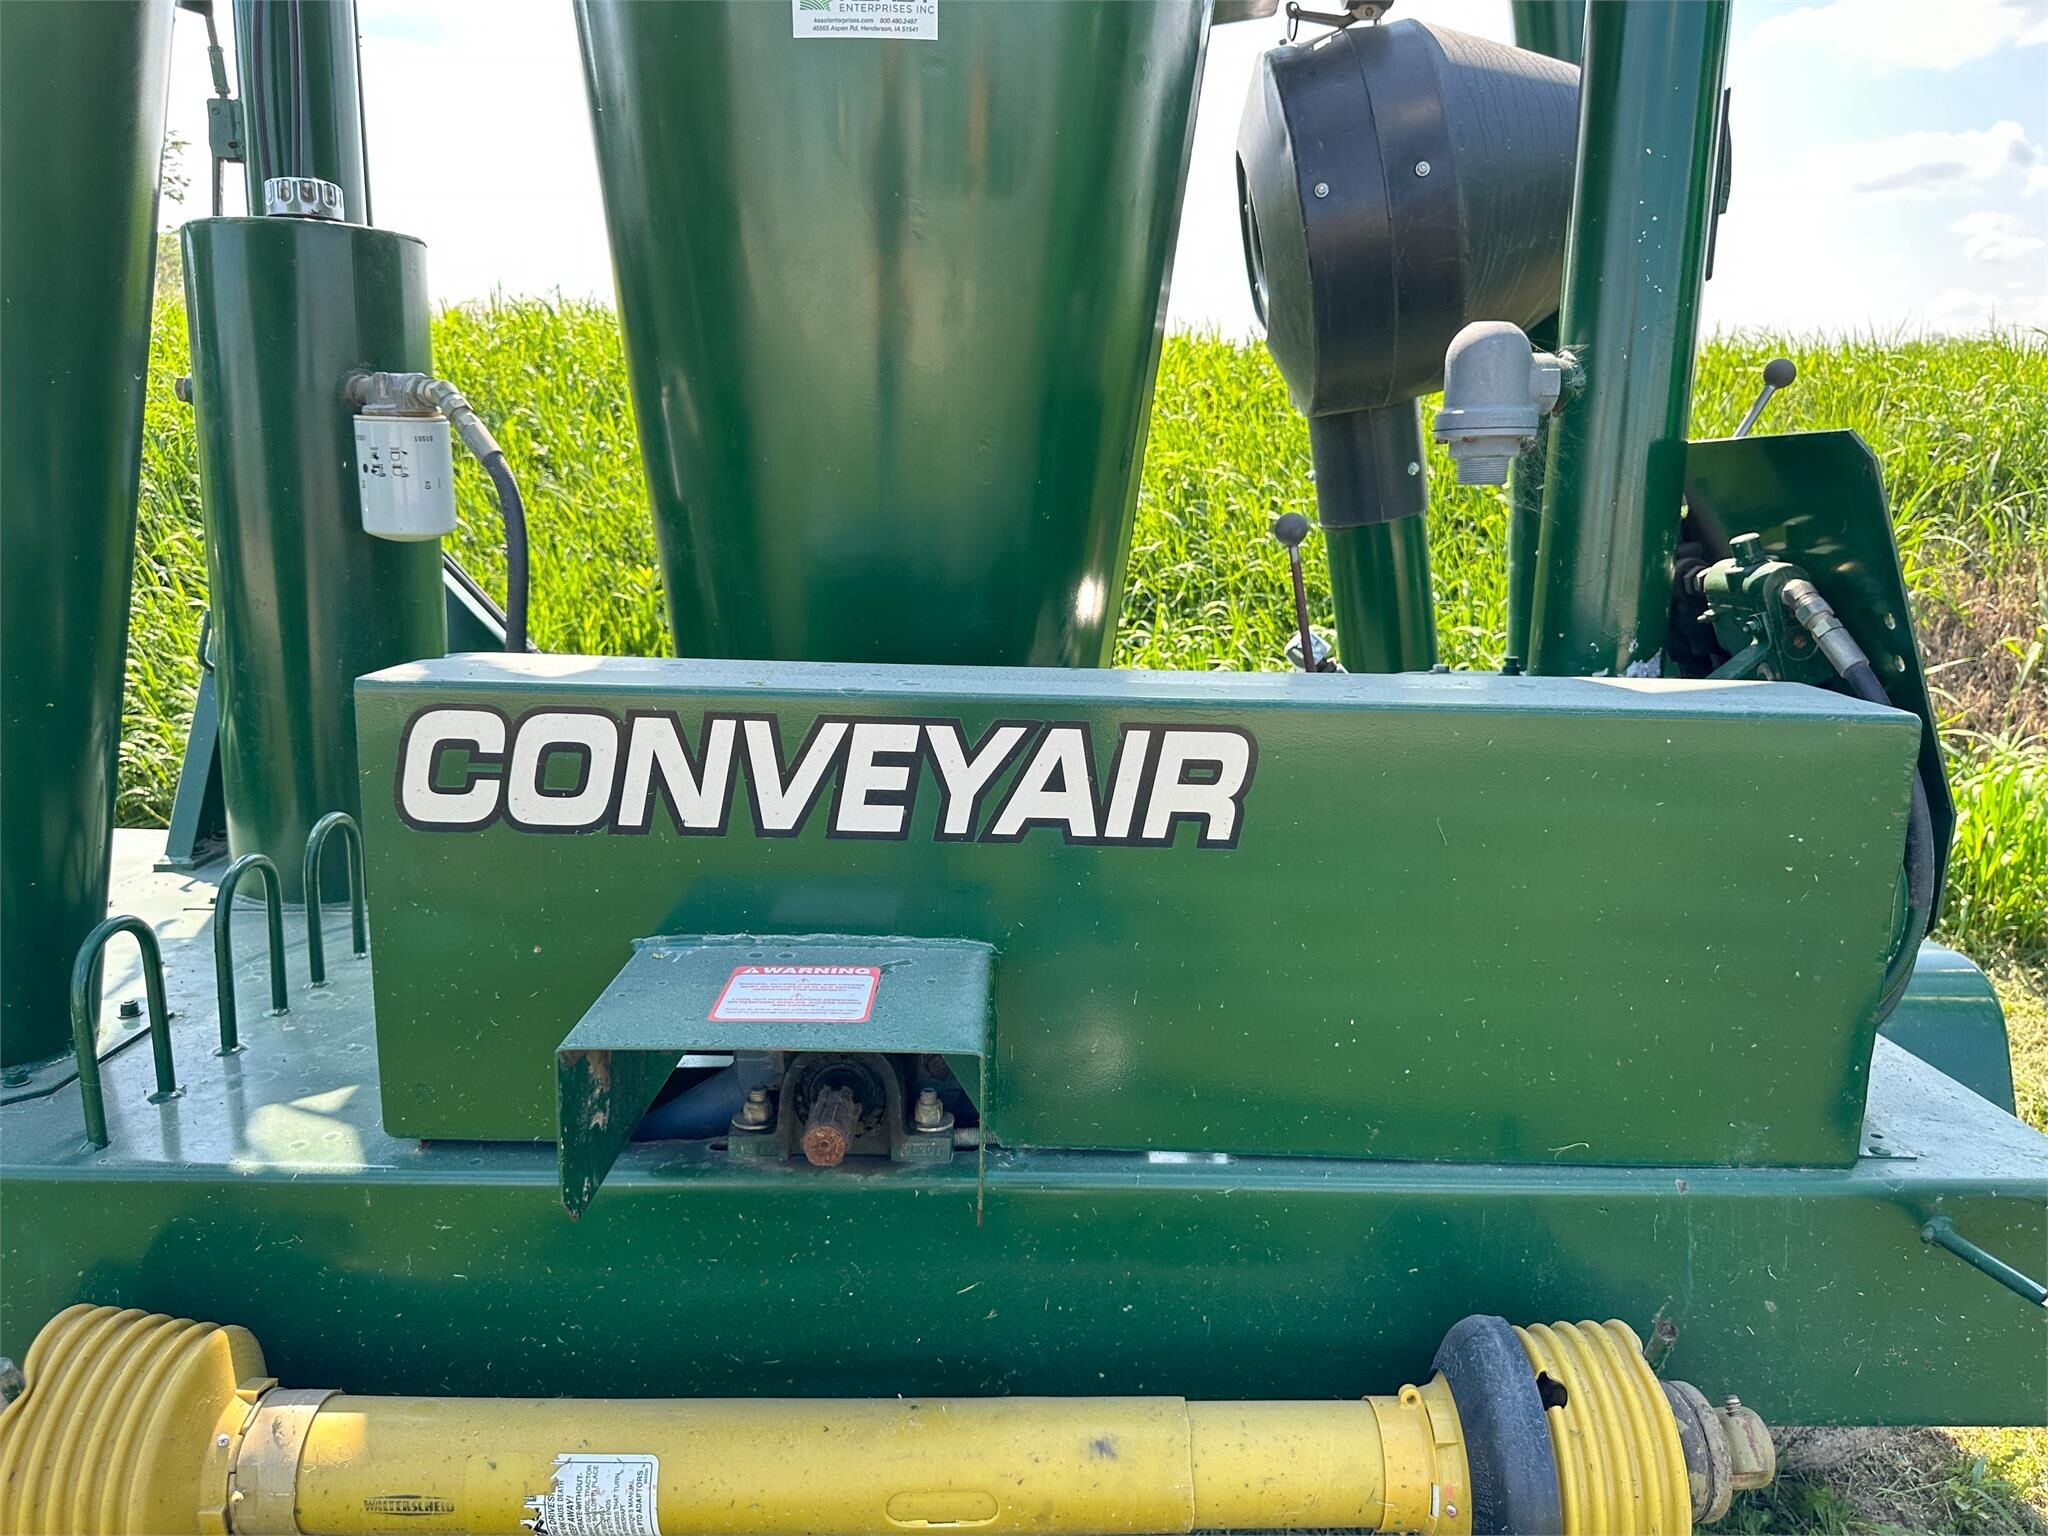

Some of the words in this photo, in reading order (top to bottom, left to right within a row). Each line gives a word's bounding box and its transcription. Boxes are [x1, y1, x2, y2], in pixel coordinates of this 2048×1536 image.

[839, 3, 912, 13] ENTERPRISES
[917, 5, 935, 14] INC
[398, 706, 1252, 846] CONVEYAIR
[763, 967, 871, 975] WARNING
[591, 1465, 599, 1488] PLACE
[636, 1470, 644, 1513] ADAPTORS
[363, 1500, 455, 1512] WALTERSCHEID
[547, 1496, 556, 1525] DRIVES
[566, 1495, 575, 1522] AWAY!
